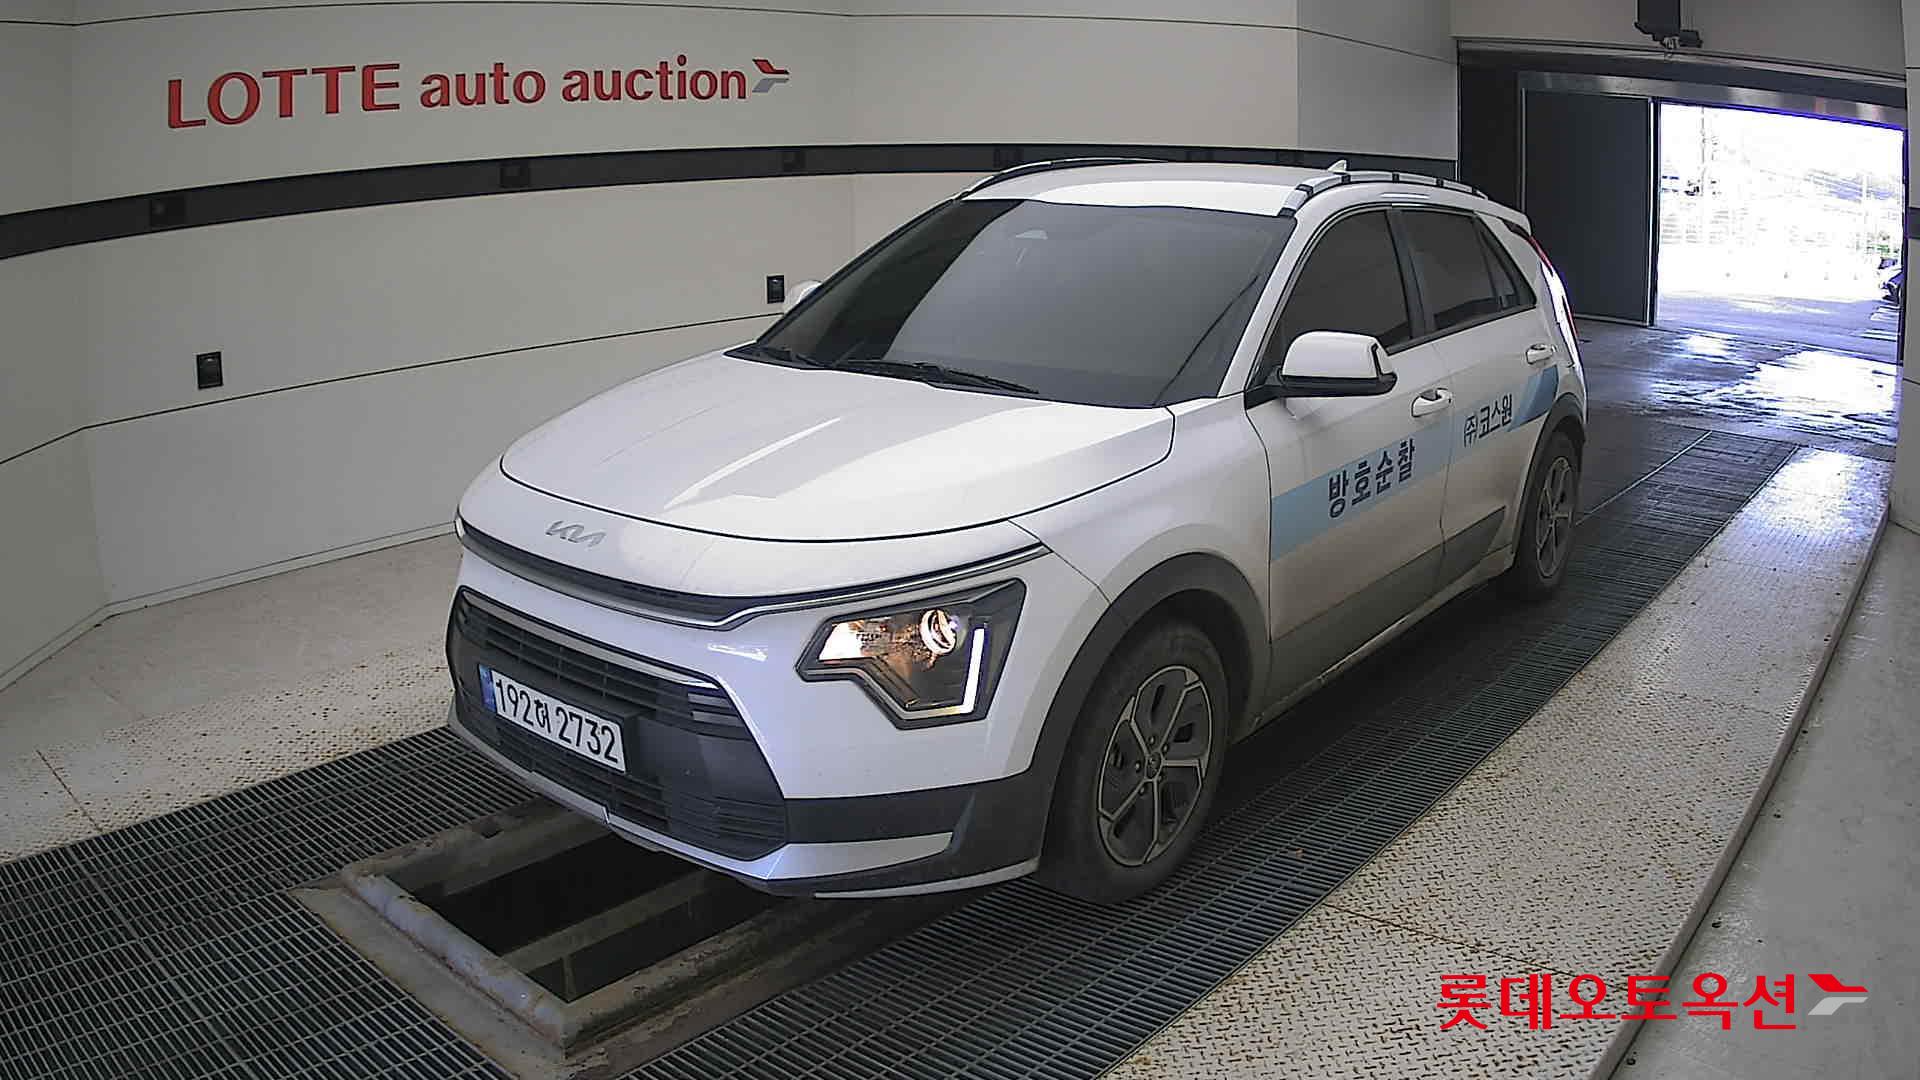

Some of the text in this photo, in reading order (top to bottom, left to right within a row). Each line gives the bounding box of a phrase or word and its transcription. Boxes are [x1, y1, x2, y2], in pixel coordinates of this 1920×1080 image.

[168, 54, 748, 129] LOTTE auto auction
[1329, 438, 1415, 518] 방호순찰
